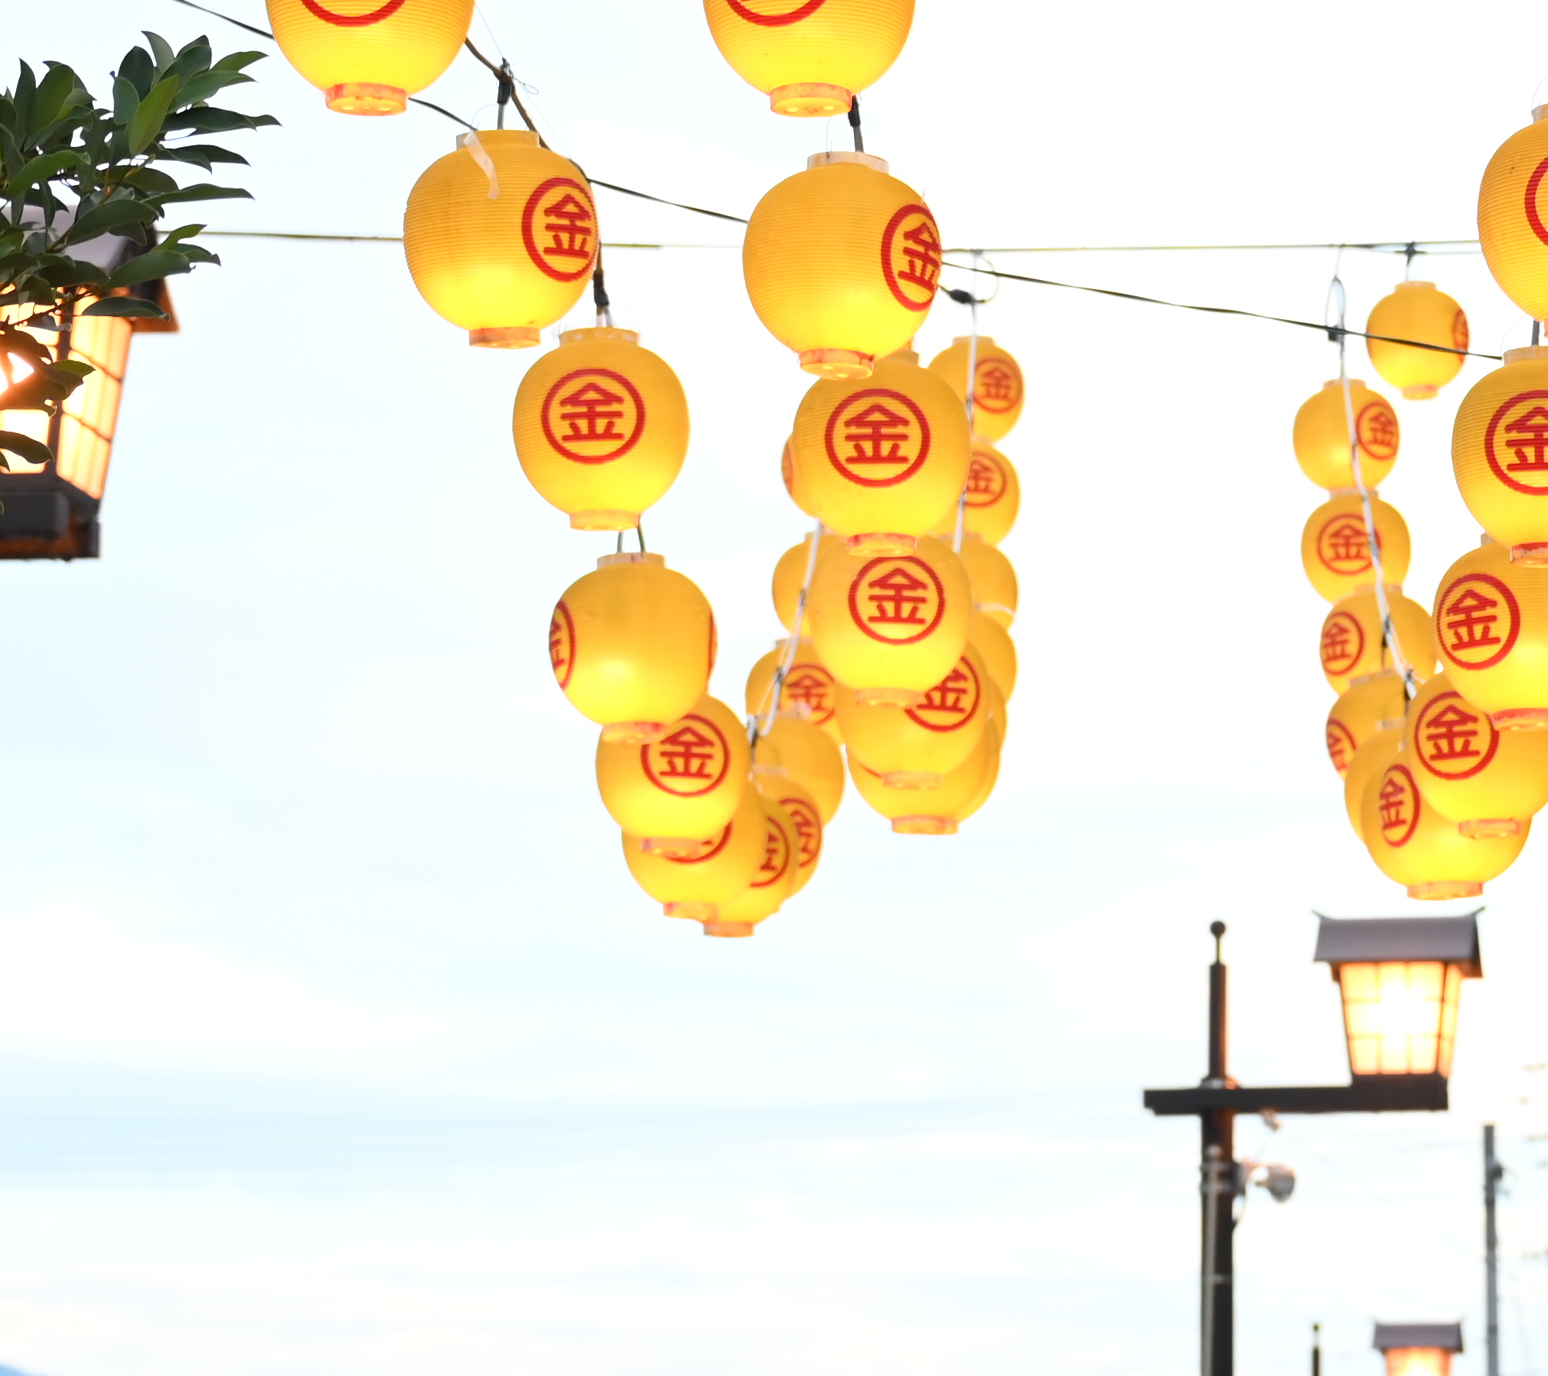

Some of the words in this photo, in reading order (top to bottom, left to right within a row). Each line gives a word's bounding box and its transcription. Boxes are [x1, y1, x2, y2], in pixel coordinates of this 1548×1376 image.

[544, 194, 592, 259] 金
[899, 216, 941, 292] 金
[980, 367, 1015, 401] 金
[560, 382, 625, 443] 金
[844, 403, 910, 464] 金
[1369, 413, 1396, 446] 金
[1330, 525, 1369, 560] 金
[868, 567, 929, 625] 金
[1447, 589, 1501, 651] 金
[1322, 623, 1350, 662] 金
[659, 726, 716, 780] 金
[1425, 704, 1481, 759] 金
[1380, 779, 1405, 830] 金
